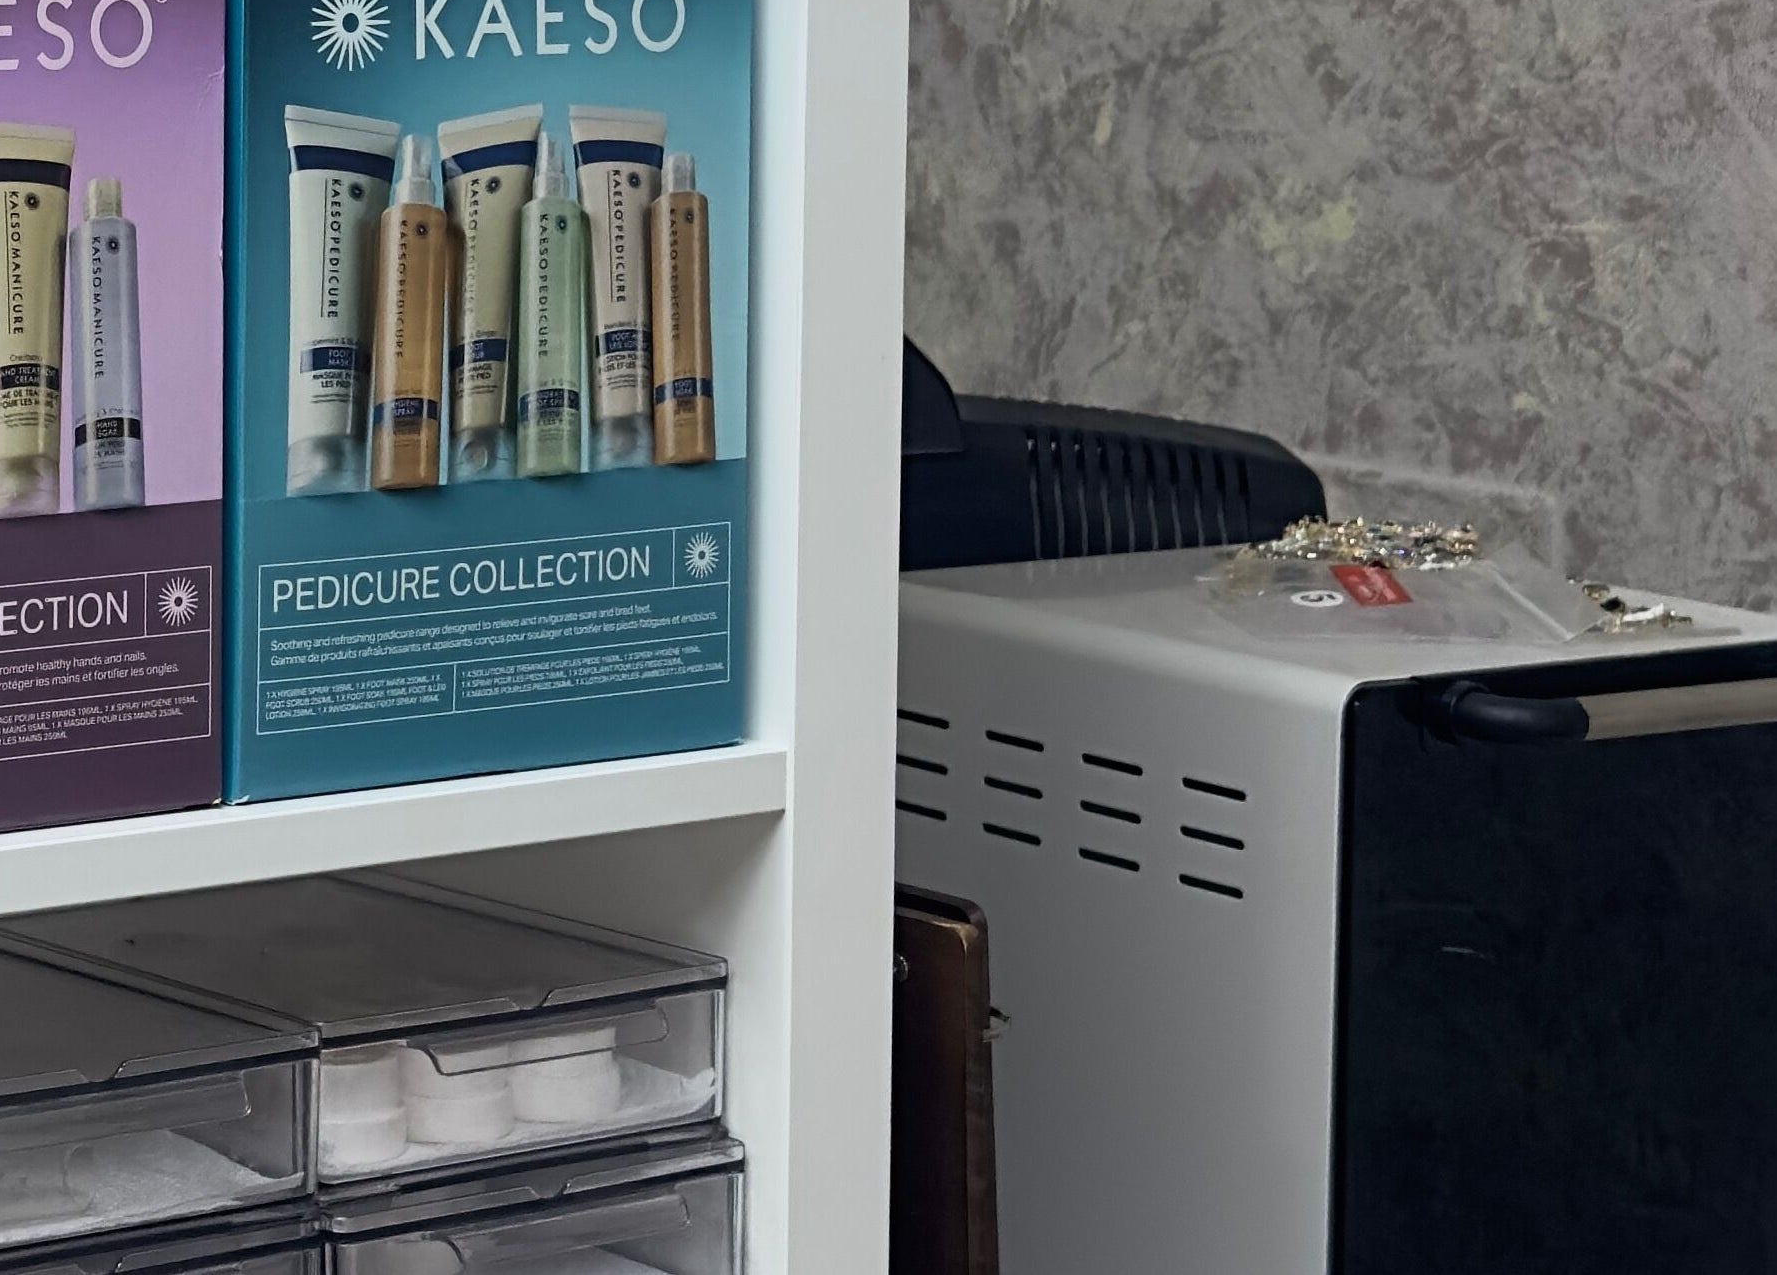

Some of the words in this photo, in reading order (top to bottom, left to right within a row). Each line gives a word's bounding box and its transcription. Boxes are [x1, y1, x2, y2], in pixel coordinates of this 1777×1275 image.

[272, 565, 440, 613] PEDICURE
[449, 545, 651, 596] COLLECTION
[73, 654, 101, 667] hands
[103, 653, 121, 664] and
